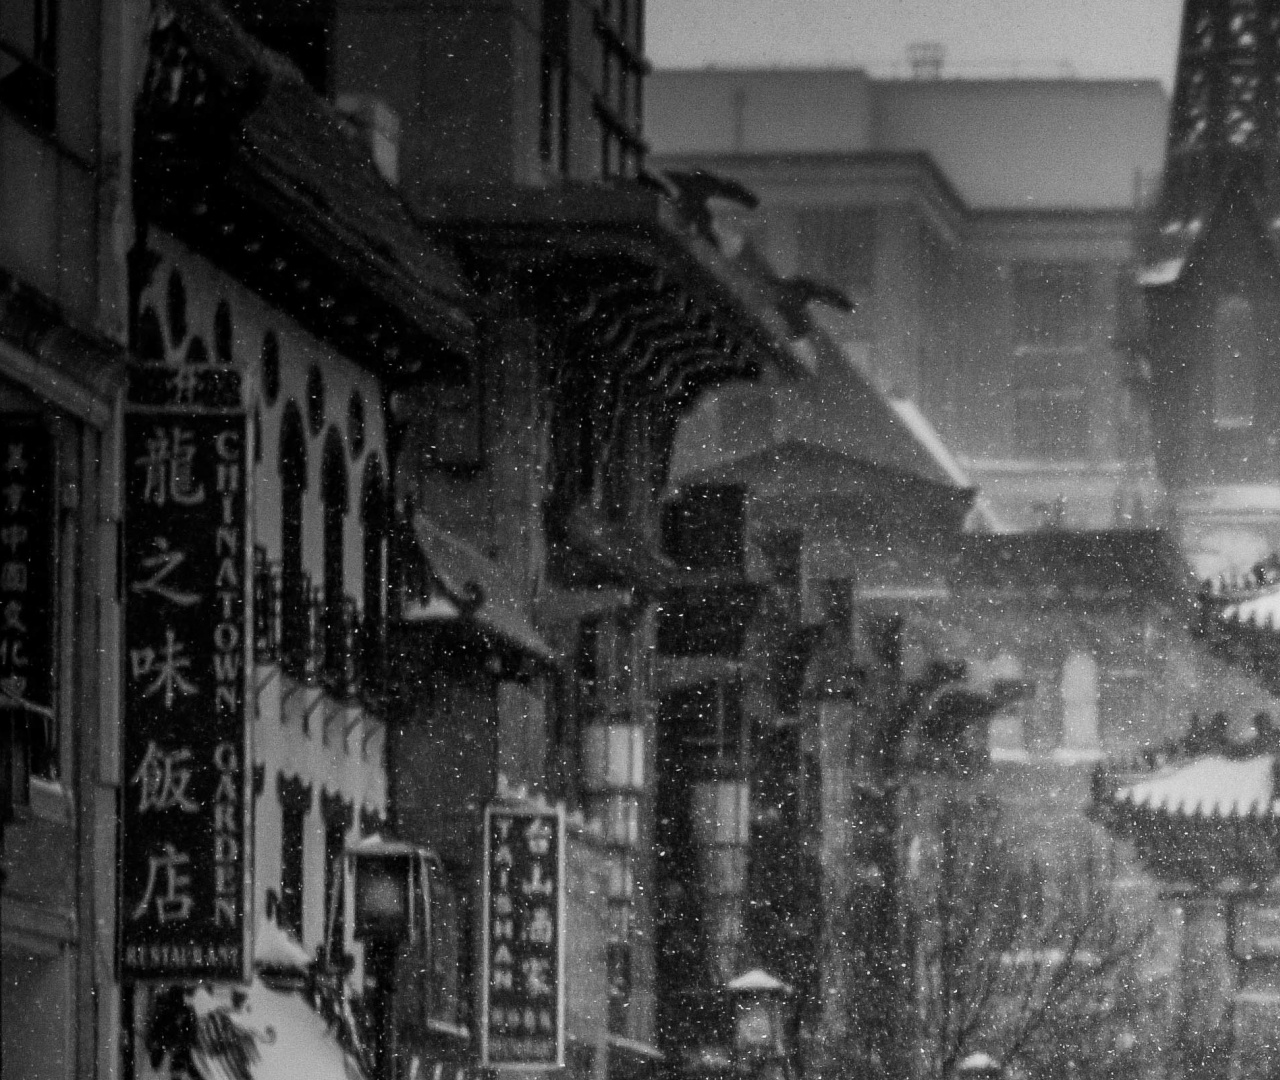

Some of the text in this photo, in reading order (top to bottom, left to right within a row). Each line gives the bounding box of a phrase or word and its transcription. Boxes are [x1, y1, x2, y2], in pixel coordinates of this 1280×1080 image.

[130, 425, 206, 923] 龍之味飯店
[213, 429, 241, 928] CHINATOWN GARDEN
